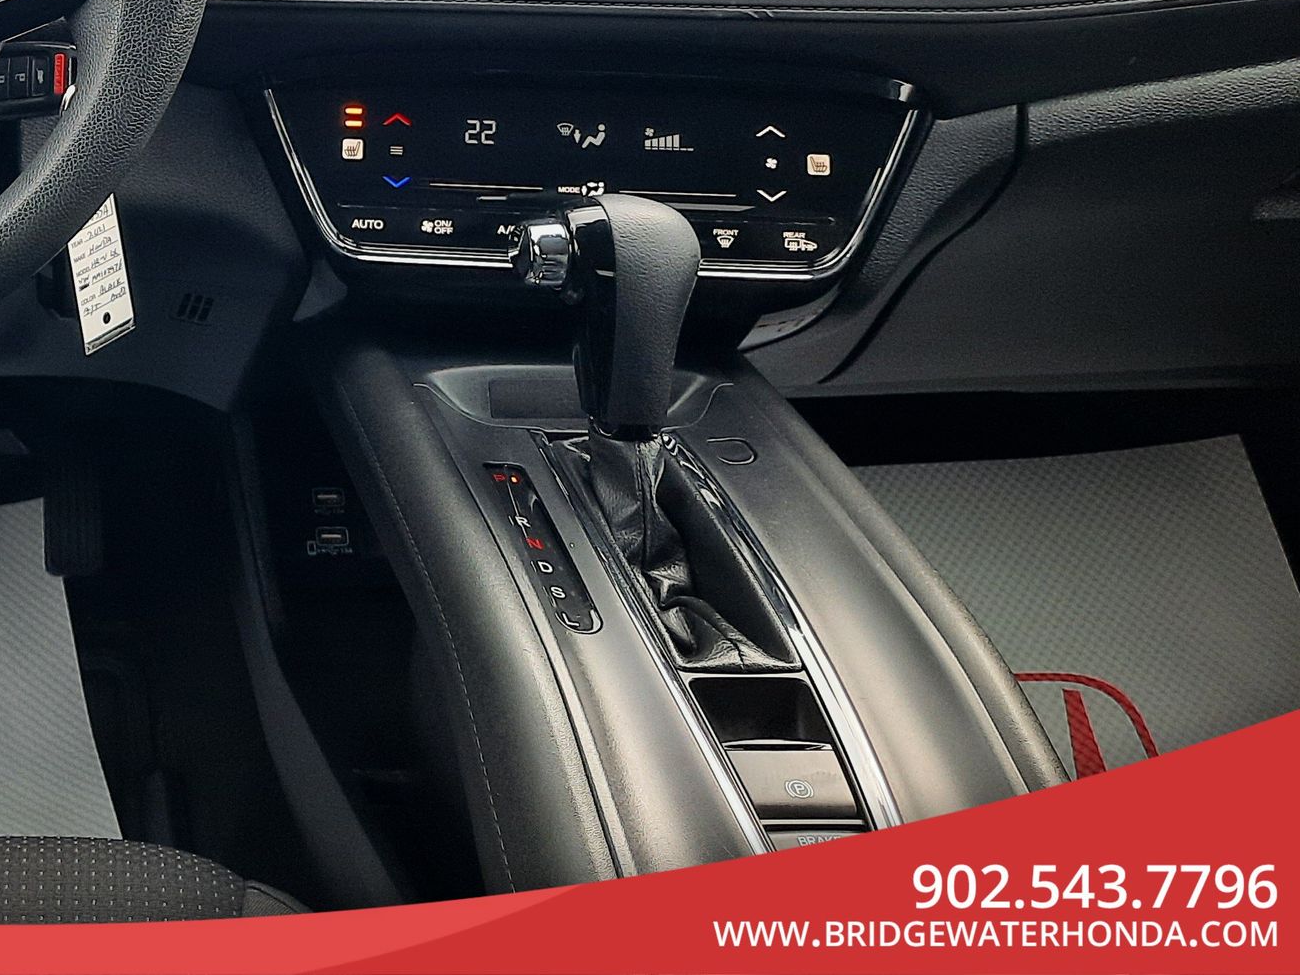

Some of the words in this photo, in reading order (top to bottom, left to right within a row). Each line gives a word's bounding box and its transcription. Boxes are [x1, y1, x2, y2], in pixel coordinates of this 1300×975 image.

[464, 119, 496, 145] 22
[557, 186, 581, 194] MODE
[351, 218, 384, 230] AUTO
[434, 219, 453, 228] ON/
[434, 227, 454, 235] OFF
[713, 228, 739, 236] FRONT
[515, 516, 531, 527] R
[526, 538, 544, 550] N
[538, 561, 554, 573] D
[550, 586, 566, 598] S
[562, 612, 580, 627] L
[797, 836, 842, 847] BRA
